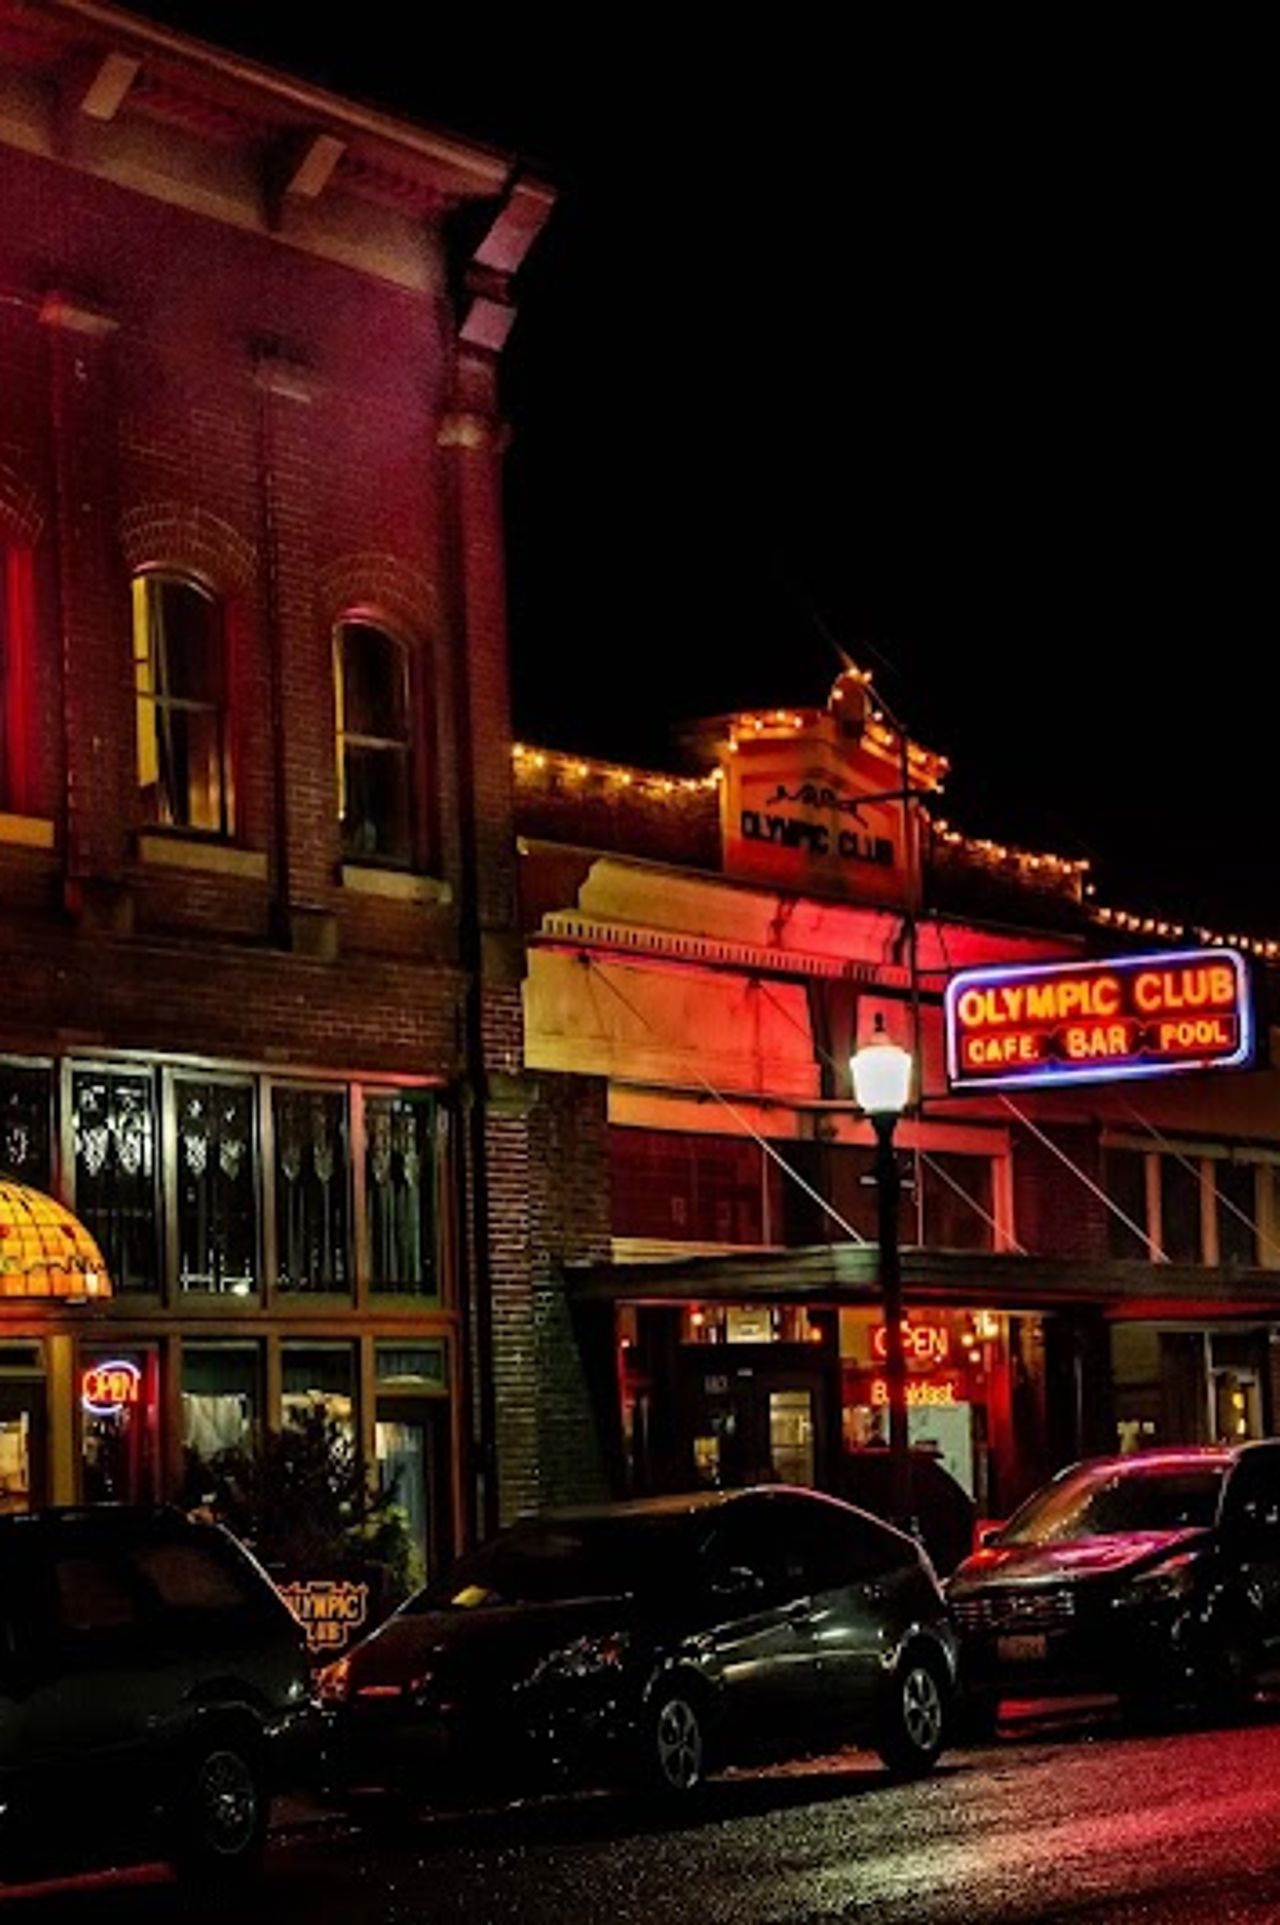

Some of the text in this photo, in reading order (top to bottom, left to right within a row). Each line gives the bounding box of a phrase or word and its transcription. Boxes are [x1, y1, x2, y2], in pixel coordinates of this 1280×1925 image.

[742, 811, 828, 854] OLYMPIC
[957, 965, 1234, 1027] OLYMPIC CLUB
[1066, 1025, 1128, 1058] BAR
[1160, 1020, 1228, 1056] POOL
[82, 1371, 138, 1401] OPEN
